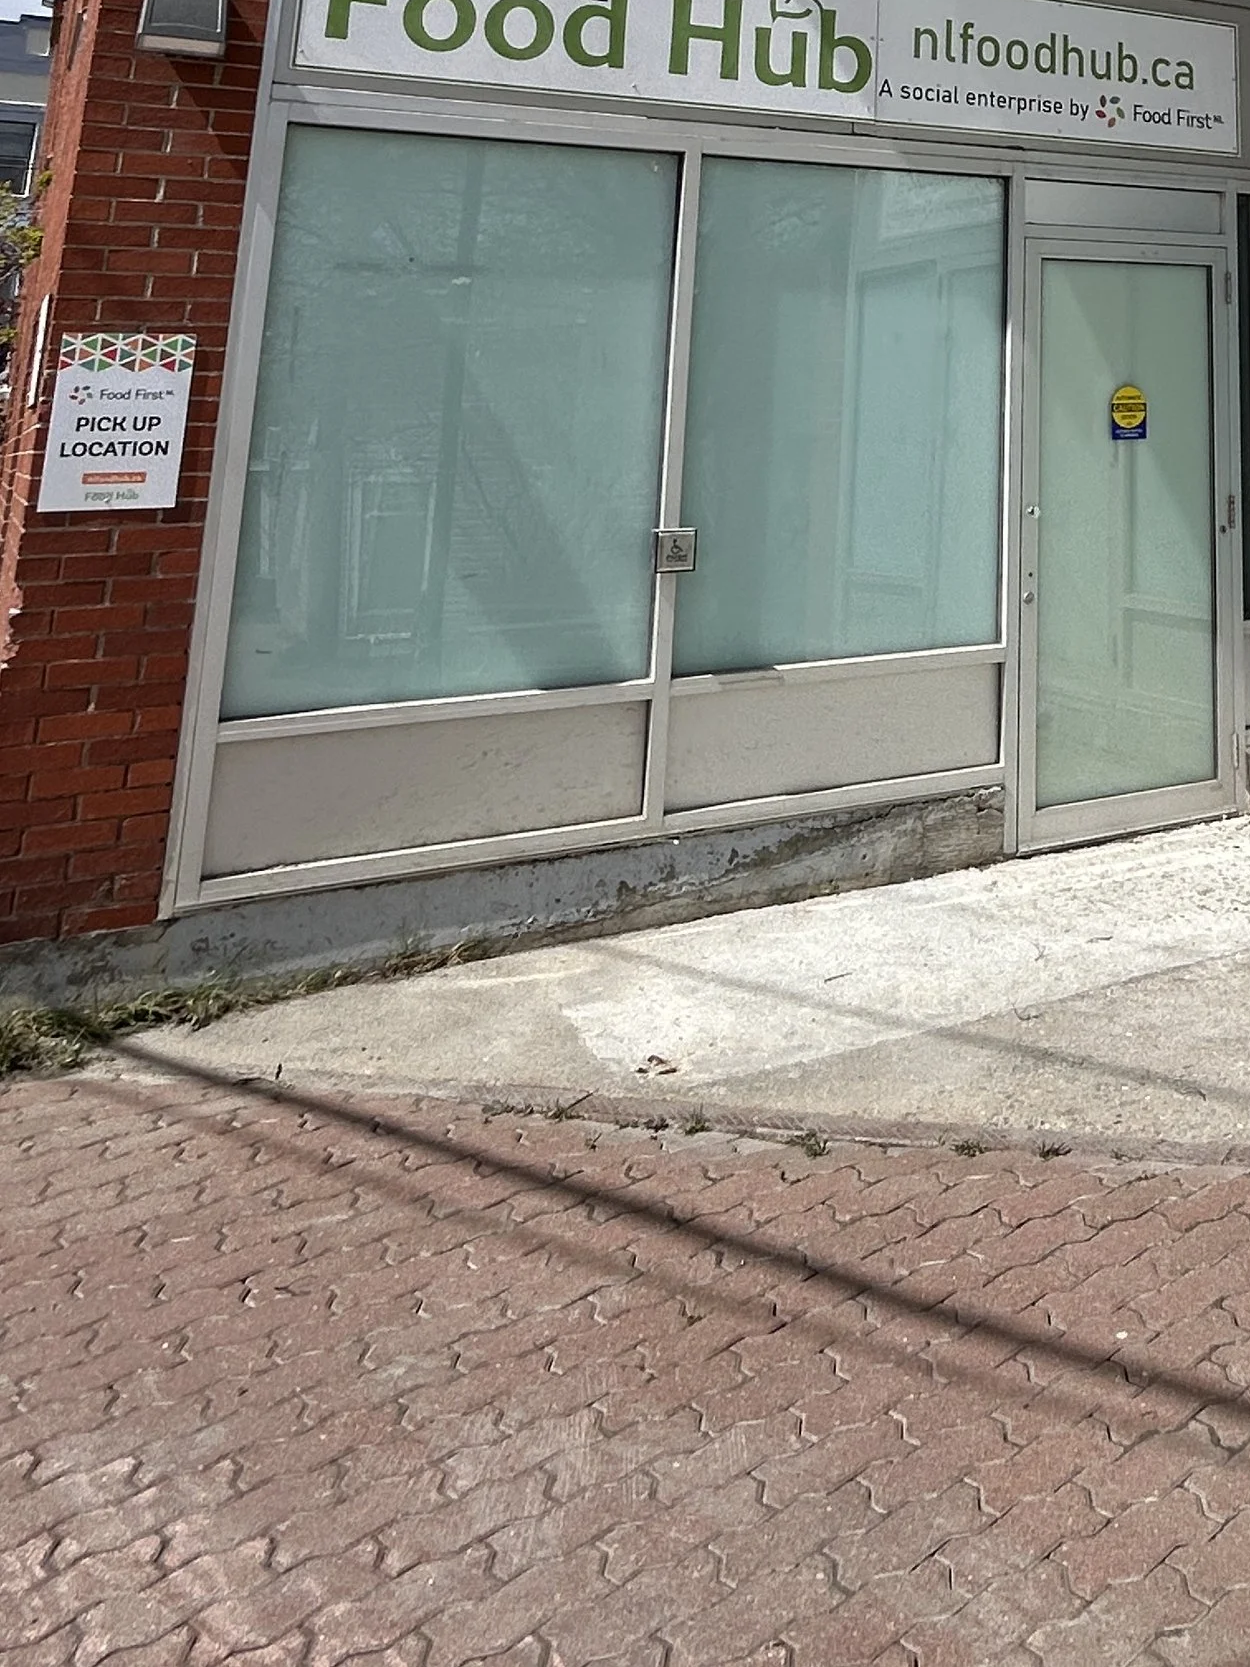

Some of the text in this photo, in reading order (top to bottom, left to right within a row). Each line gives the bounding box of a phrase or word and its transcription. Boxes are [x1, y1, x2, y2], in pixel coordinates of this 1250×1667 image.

[912, 18, 1195, 91] nlfoodhub.ca
[878, 79, 893, 98] A
[900, 84, 959, 105] social
[965, 89, 1064, 115] enterprise
[1069, 97, 1090, 121] by
[1132, 103, 1172, 126] Food
[99, 388, 132, 401] Food
[75, 416, 162, 433] PICK UP
[59, 440, 170, 458] LOCATION
